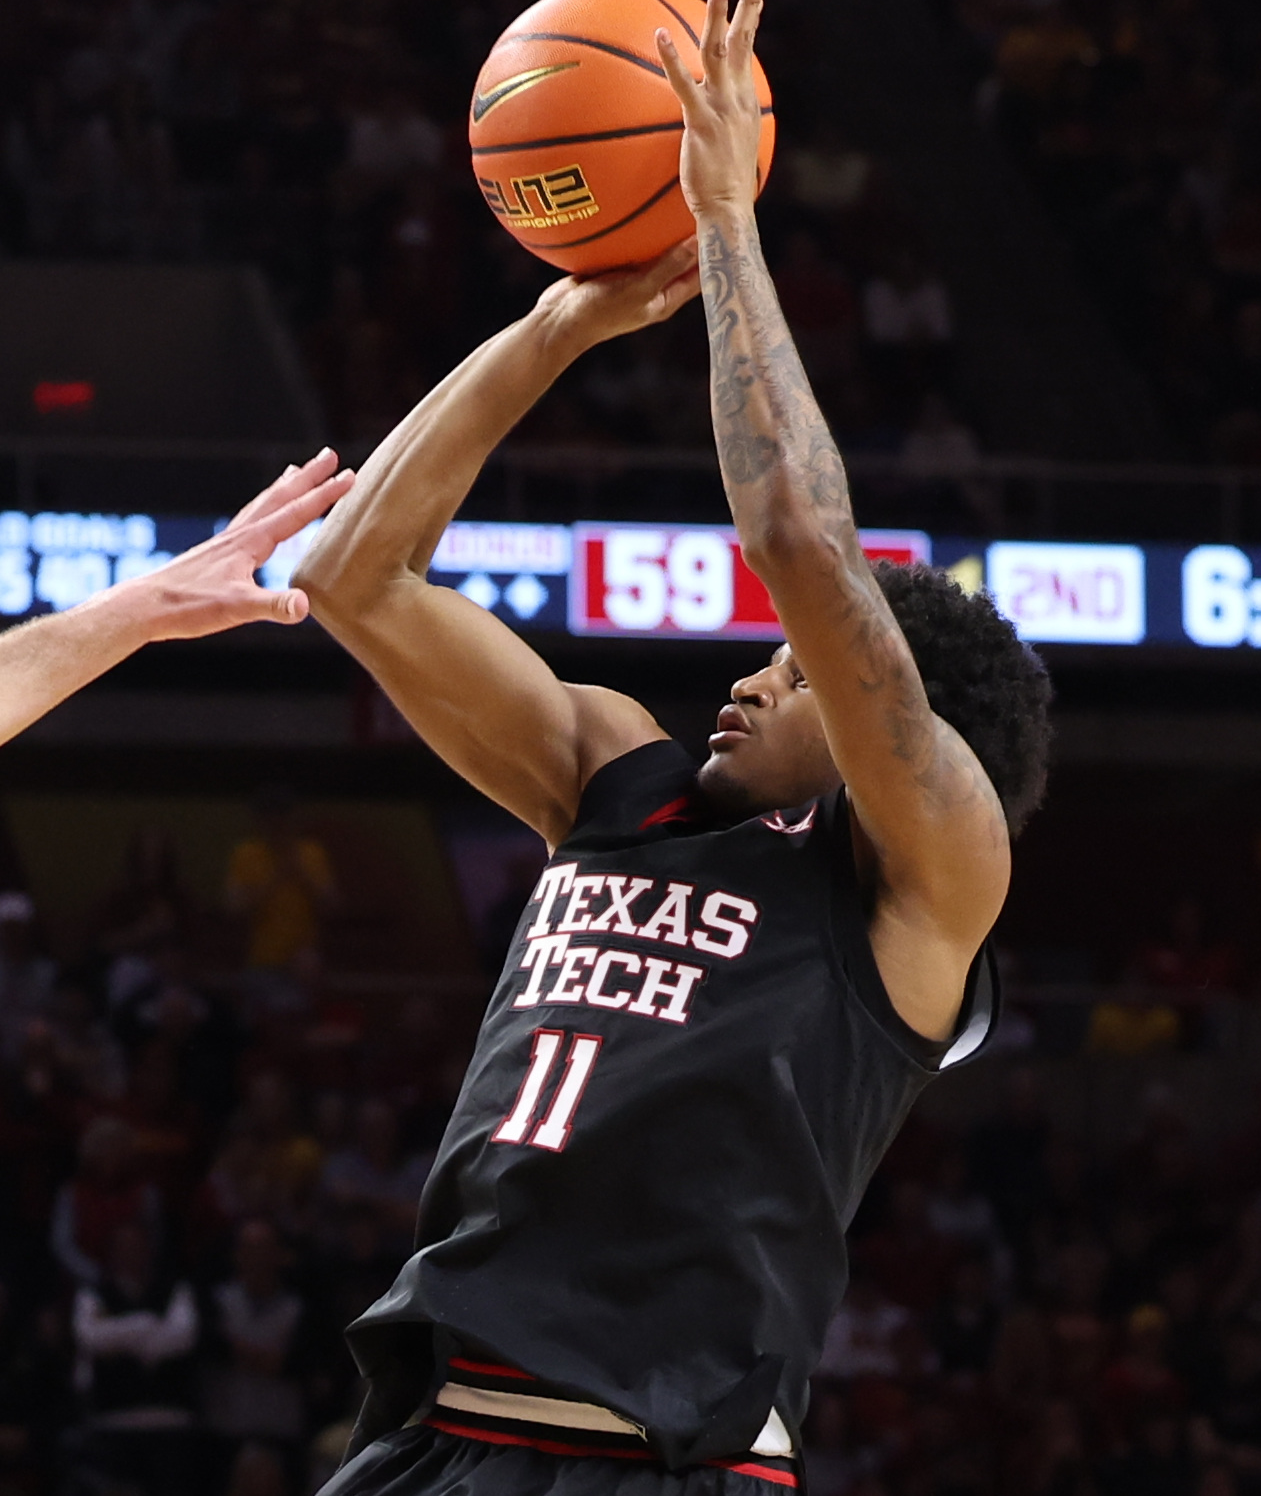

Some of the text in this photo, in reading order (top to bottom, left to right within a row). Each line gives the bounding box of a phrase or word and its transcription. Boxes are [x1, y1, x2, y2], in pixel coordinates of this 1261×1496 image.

[479, 163, 596, 220] ELITE
[603, 528, 735, 633] 59
[1010, 563, 1126, 624] 2ND
[525, 861, 759, 961] TEXAS
[511, 932, 708, 1026] TECH
[491, 1027, 603, 1153] 11
